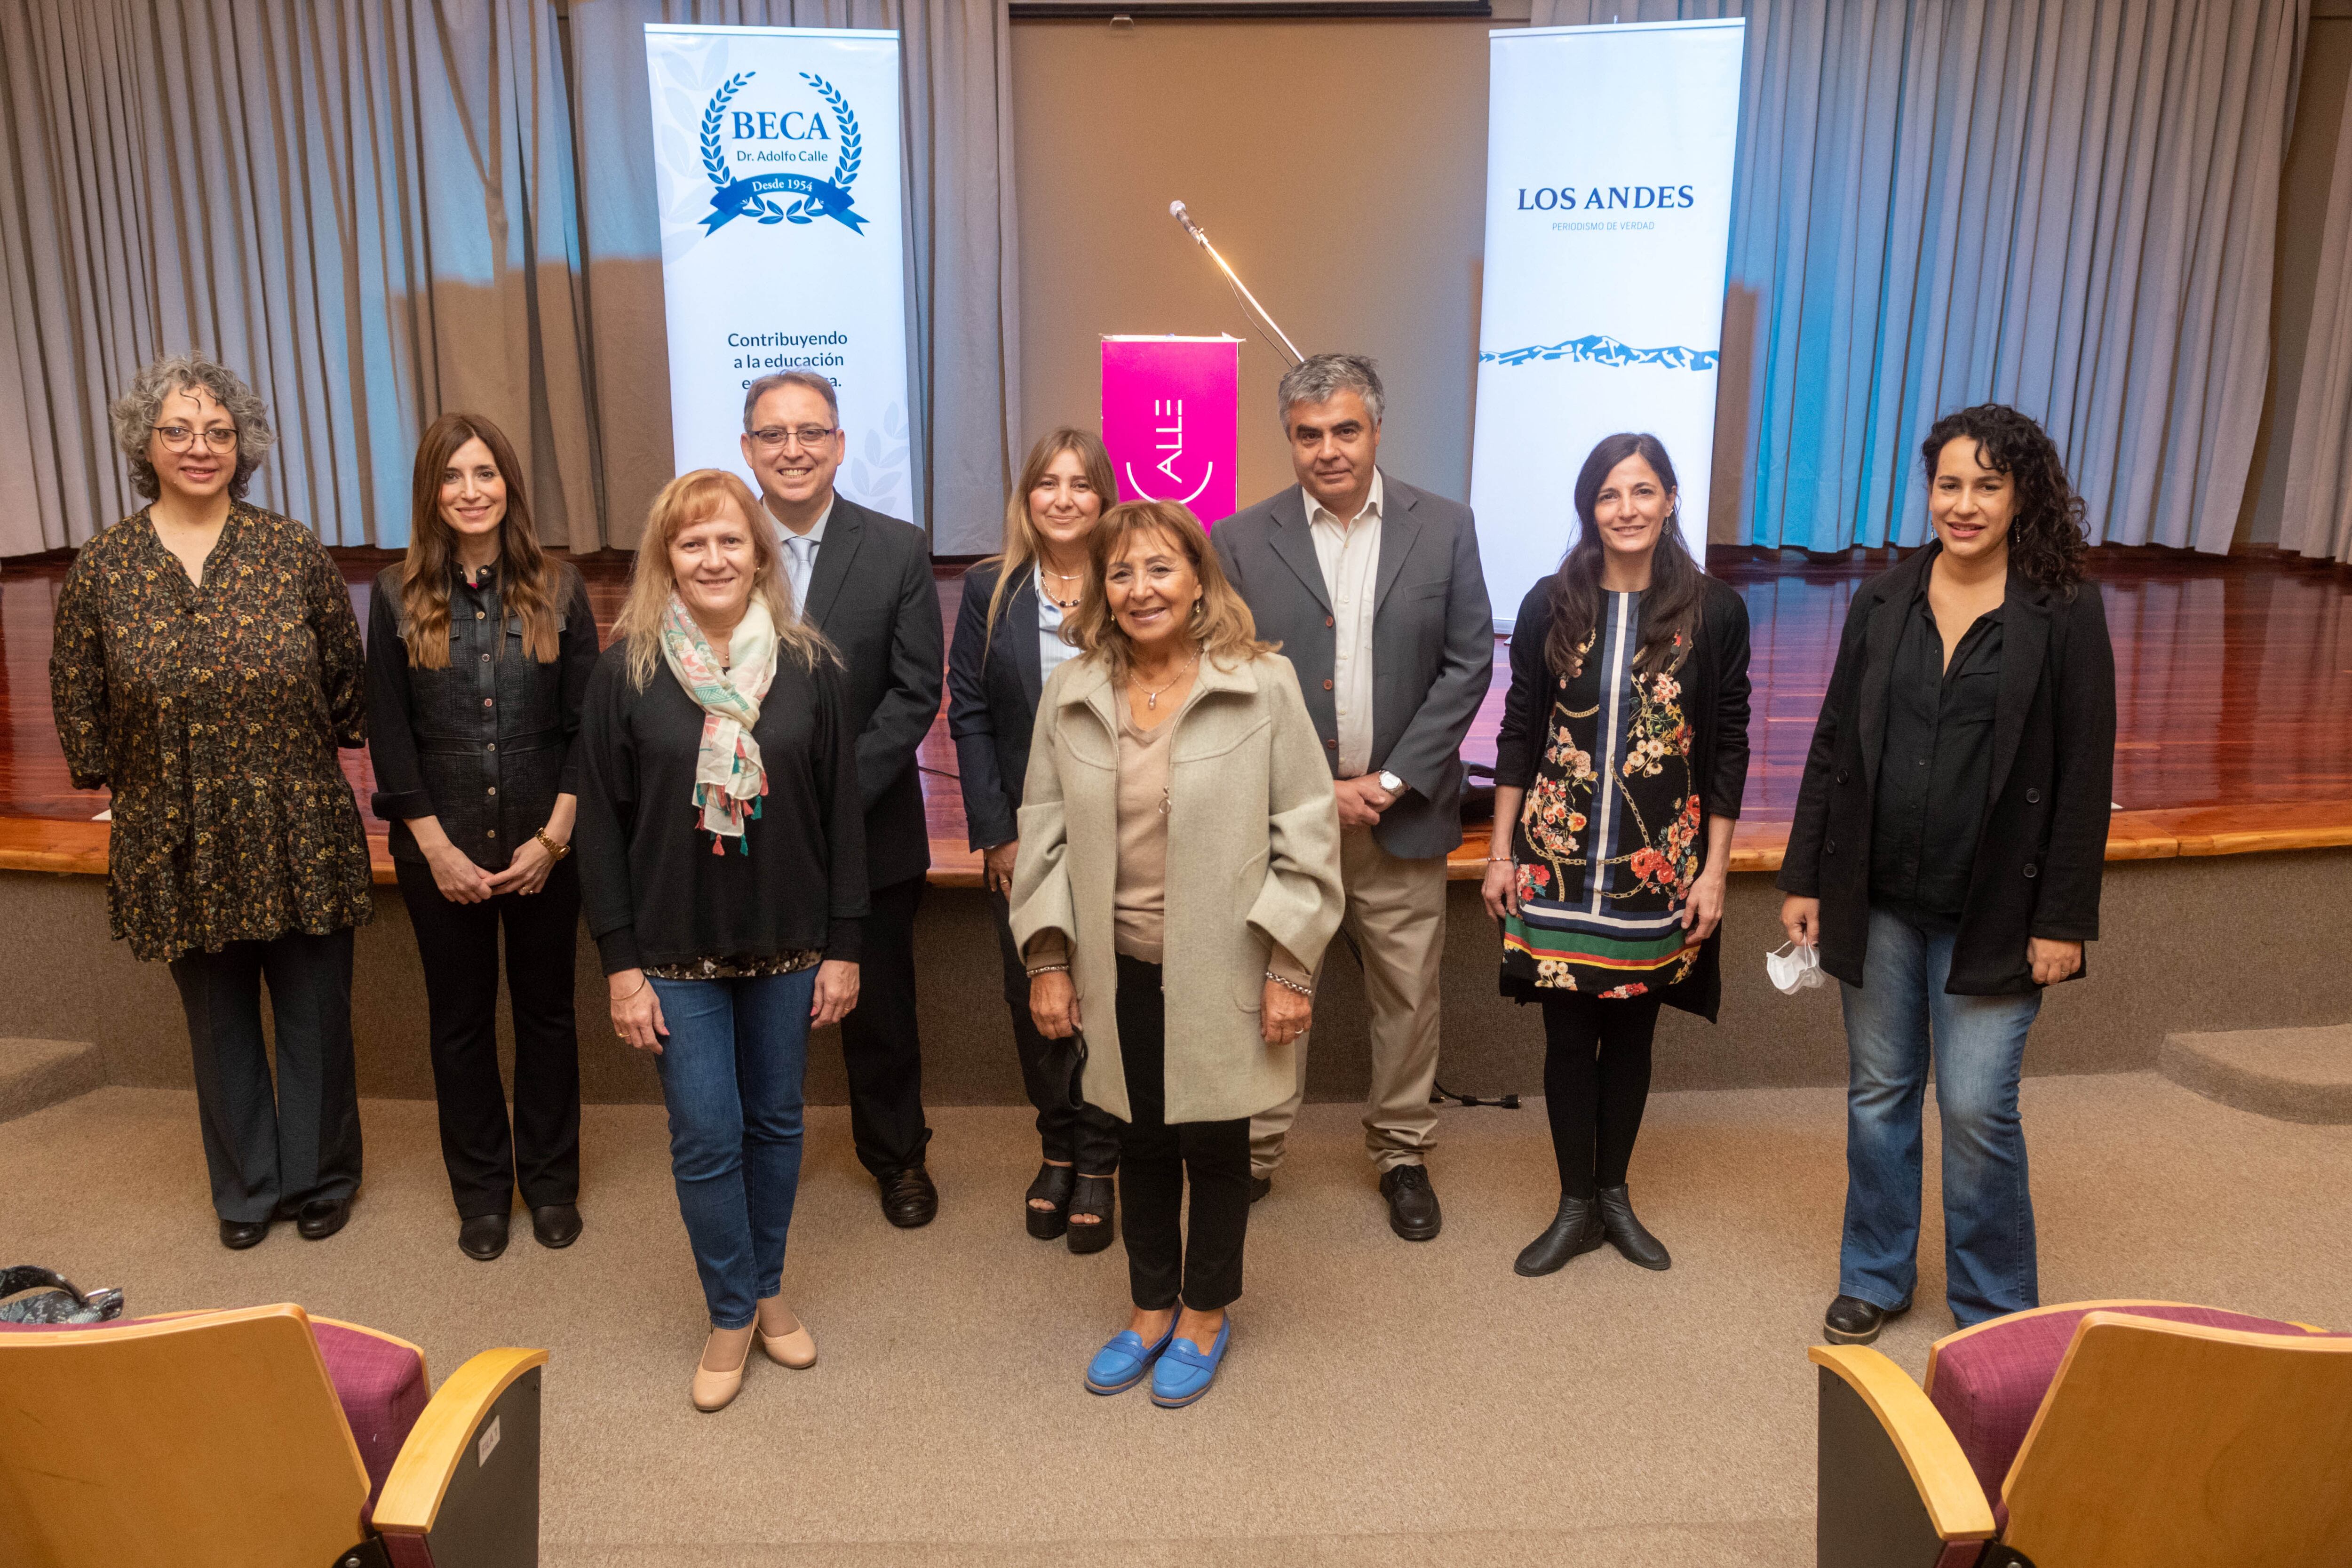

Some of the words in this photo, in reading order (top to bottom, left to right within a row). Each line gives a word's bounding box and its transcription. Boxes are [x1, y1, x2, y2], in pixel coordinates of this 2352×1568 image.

[731, 111, 831, 141] BECA
[737, 150, 754, 162] Dr.
[757, 150, 796, 162] Adolfo
[798, 150, 828, 162] Calle
[752, 178, 785, 192] Desde
[788, 179, 813, 192] 1954
[1517, 187, 1576, 210] LOS
[1583, 185, 1694, 210] ANDES
[1552, 222, 1604, 231] PERIODISMO
[1606, 222, 1618, 230] DE
[1620, 221, 1654, 230] VERDAD
[727, 330, 848, 349] Contribuyendo
[734, 358, 742, 368] a
[747, 354, 760, 368] la
[764, 352, 844, 369] educación
